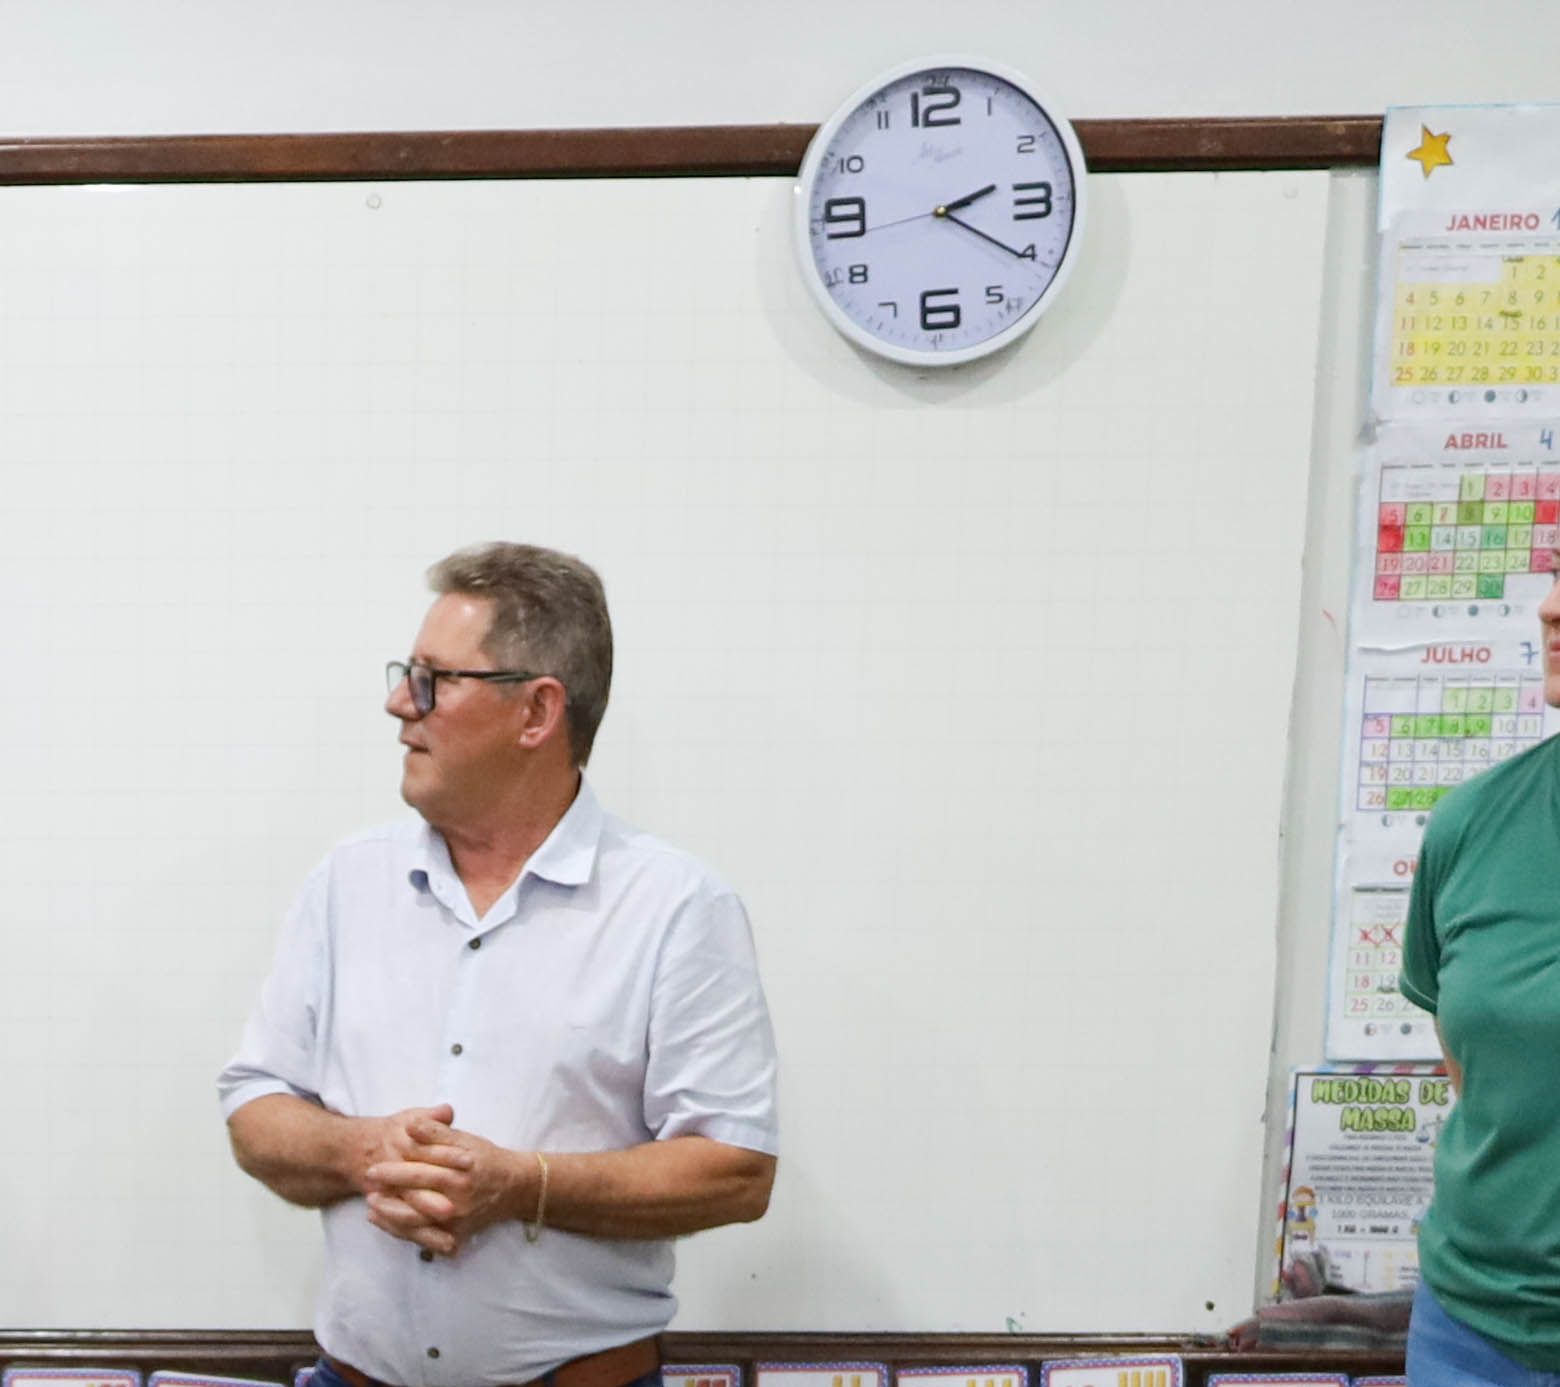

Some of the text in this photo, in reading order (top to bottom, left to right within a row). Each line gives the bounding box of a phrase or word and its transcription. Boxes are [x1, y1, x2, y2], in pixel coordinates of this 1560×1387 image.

[911, 86, 961, 128] 12
[987, 98, 992, 116] 1
[877, 111, 889, 129] 11
[1017, 136, 1035, 153] 2
[839, 155, 864, 174] 10
[1012, 182, 1052, 221] 3
[825, 197, 866, 239] 9
[1445, 212, 1540, 232] JANEIRO
[1019, 244, 1037, 261] 4
[849, 264, 868, 284] 8
[986, 286, 1004, 304] 5
[878, 302, 897, 318] 7
[920, 288, 961, 331] 6
[1443, 432, 1508, 450] ABRIL
[1539, 428, 1553, 450] 4
[1421, 645, 1492, 665] JULHO
[1520, 641, 1539, 665] 7
[1312, 1077, 1449, 1105] MEDIDAS DE
[1341, 1108, 1416, 1132] MASSA
